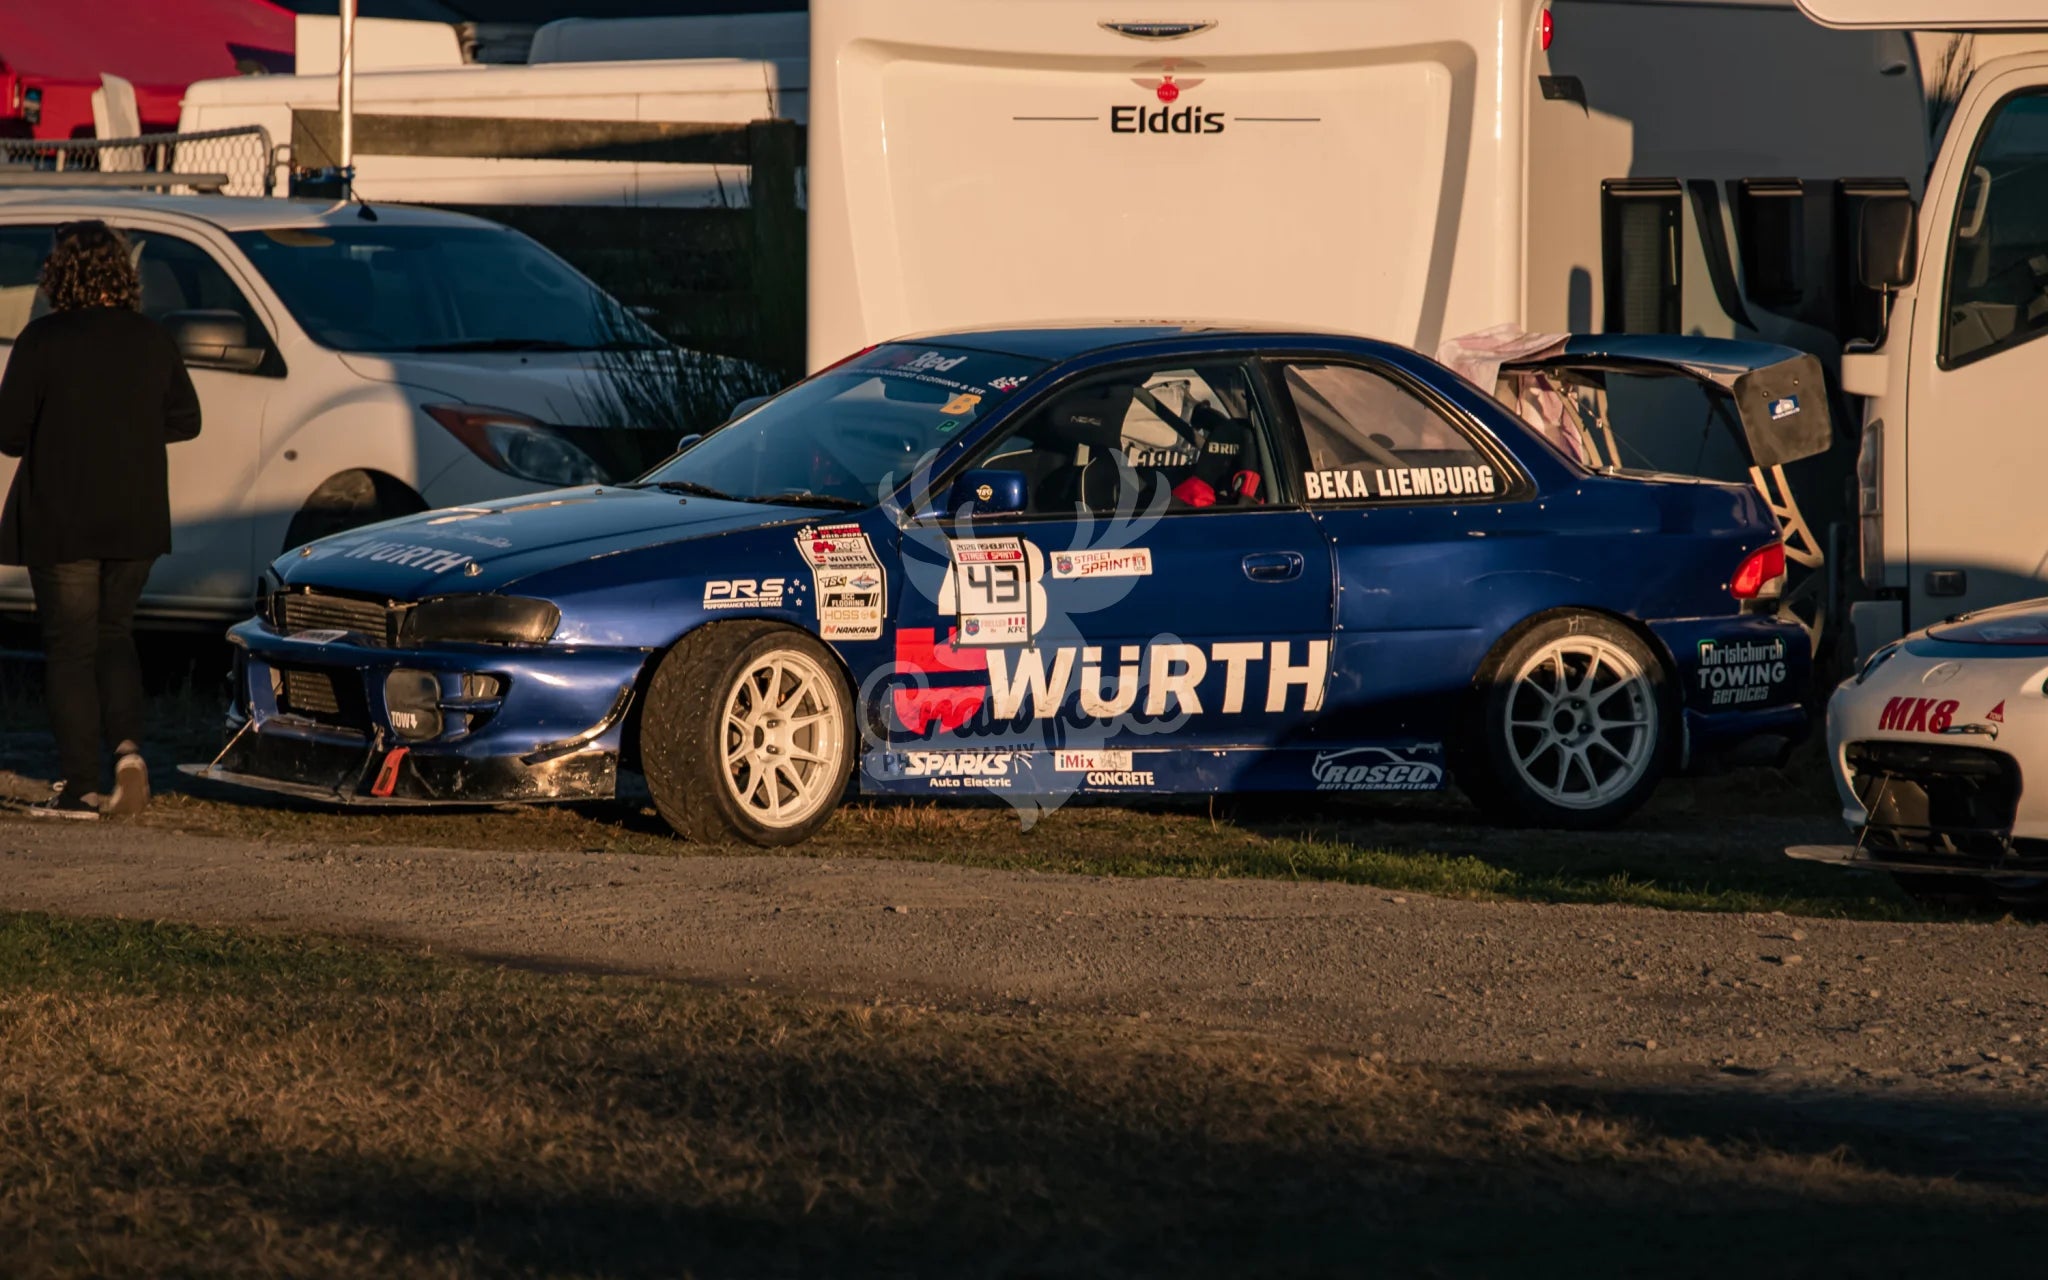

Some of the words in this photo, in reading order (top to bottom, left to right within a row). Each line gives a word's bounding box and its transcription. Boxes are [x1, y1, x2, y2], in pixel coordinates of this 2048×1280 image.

[1111, 105, 1224, 133] Elddis
[1304, 470, 1369, 499] BEKA
[1375, 465, 1495, 497] LIEMBURG
[1075, 551, 1111, 564] STREET
[1081, 557, 1130, 575] SPRINT
[703, 578, 785, 600] PRS
[967, 565, 1021, 603] 43
[1007, 626, 1025, 634] KFC
[1697, 661, 1787, 690] TOWING
[1712, 683, 1769, 705] services
[391, 711, 410, 729] TOW
[904, 752, 1014, 775] SPARKS
[1060, 754, 1094, 768] iMix
[929, 777, 960, 788] Auto
[963, 777, 1012, 788] Electric
[1086, 771, 1155, 786] CONCRETE
[1322, 765, 1431, 783] ROSCO
